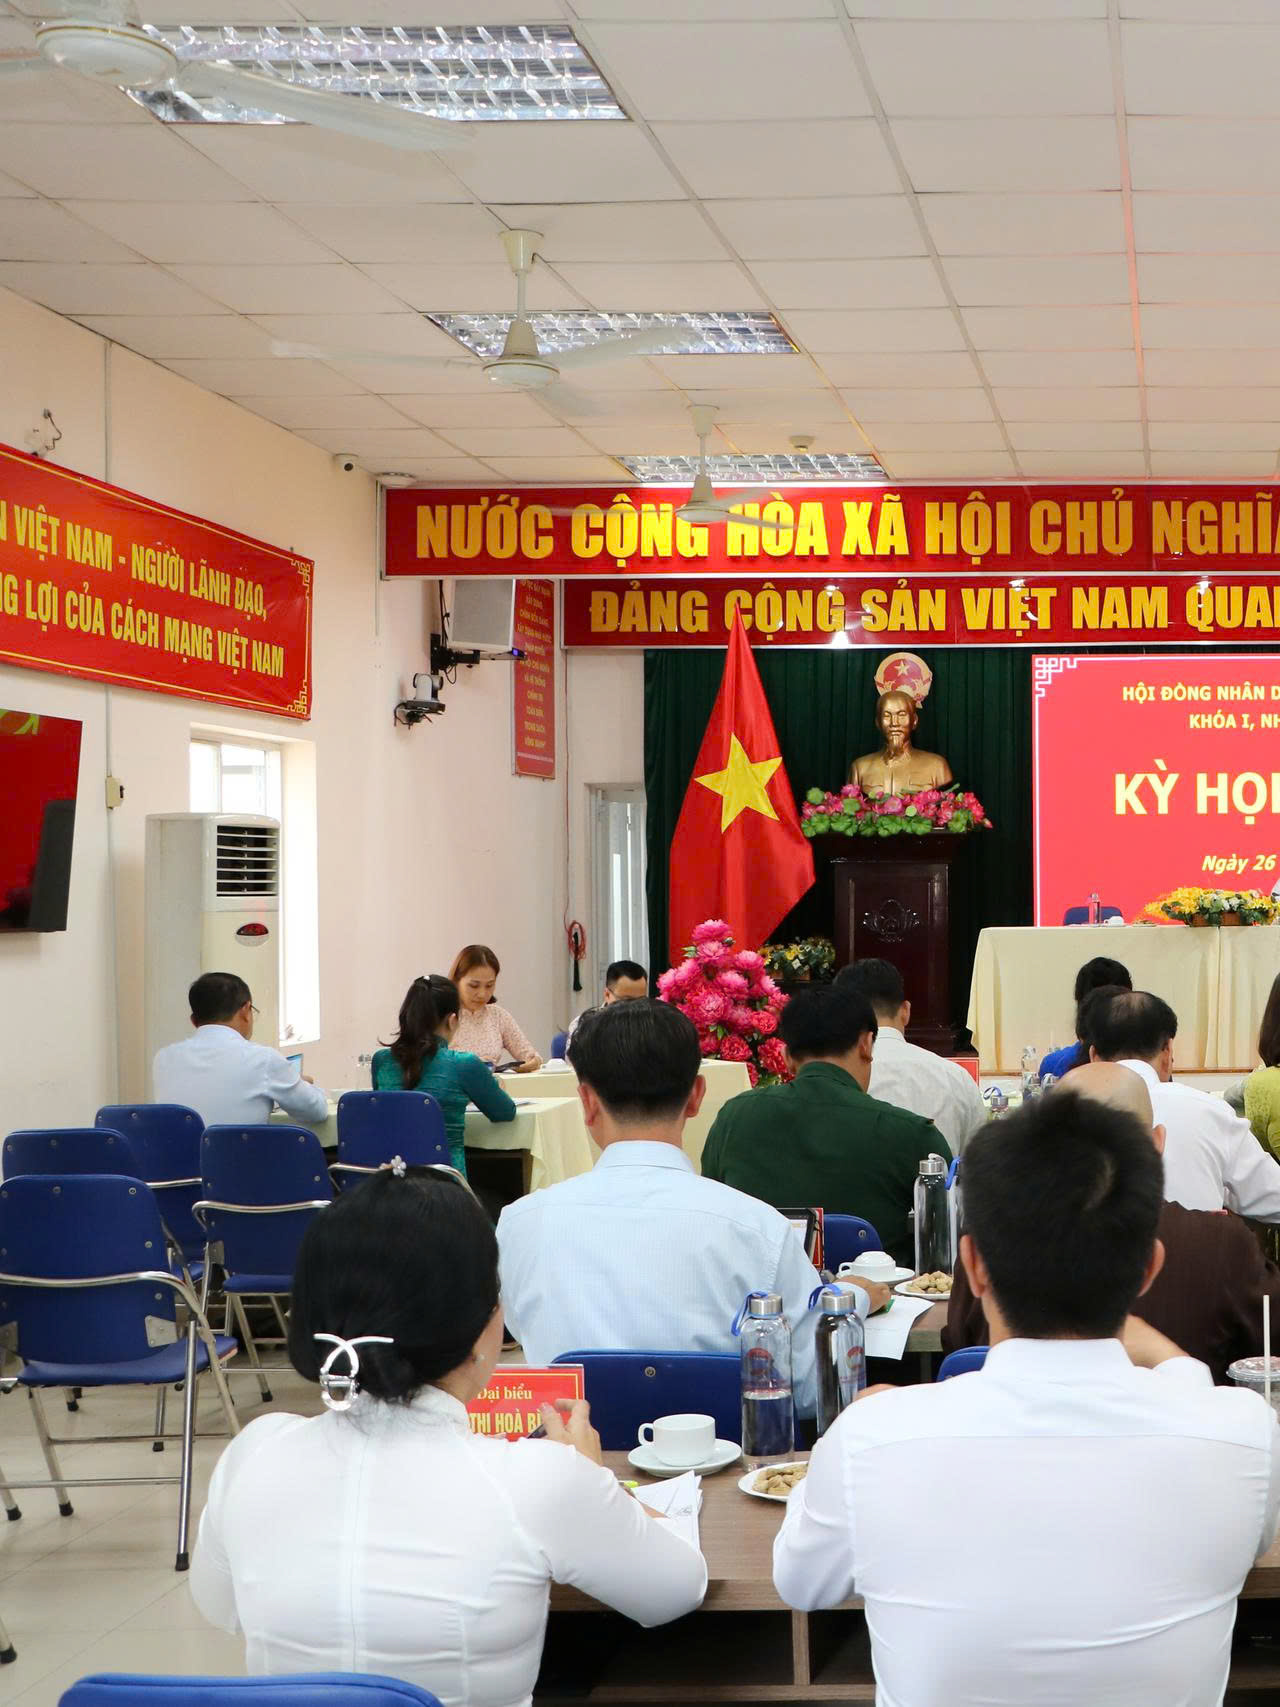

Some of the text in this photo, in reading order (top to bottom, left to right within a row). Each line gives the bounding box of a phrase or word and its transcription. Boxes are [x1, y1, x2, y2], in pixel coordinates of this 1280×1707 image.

[416, 495, 553, 560] NƯỚC
[571, 493, 709, 567] CỘNG
[727, 491, 830, 557] HÒA
[841, 494, 909, 555] XÃ
[925, 491, 1010, 565] HỘI
[1028, 487, 1132, 556] CHỦ
[14, 504, 60, 561] VIỆT
[66, 521, 112, 572] NAM
[131, 543, 184, 592] NGƯỜI
[190, 559, 230, 607] LÃNH
[234, 576, 267, 621] ĐẠO,
[26, 579, 58, 632] LỢI
[65, 582, 105, 636] CỦA
[111, 598, 159, 648] CÁCH
[164, 616, 213, 663] MẠNG
[217, 628, 248, 674] VIỆT
[252, 639, 284, 678] NAM
[590, 580, 709, 633] ĐẢNG
[724, 582, 845, 640] CỘNG
[863, 579, 946, 632] SẢN
[960, 581, 1057, 637] VIỆT
[1072, 586, 1168, 629] NAM
[1122, 682, 1155, 704] HỘI
[1161, 681, 1211, 701] ĐỒNG
[1217, 681, 1265, 700] NHÂN
[1189, 711, 1236, 729] KHÓA
[1242, 714, 1255, 731] I,
[1114, 759, 1178, 815] KỲ
[1202, 854, 1248, 874] Ngày
[1253, 854, 1277, 871] 26
[504, 1383, 532, 1400] biểu
[495, 1408, 523, 1433] HOÀ
